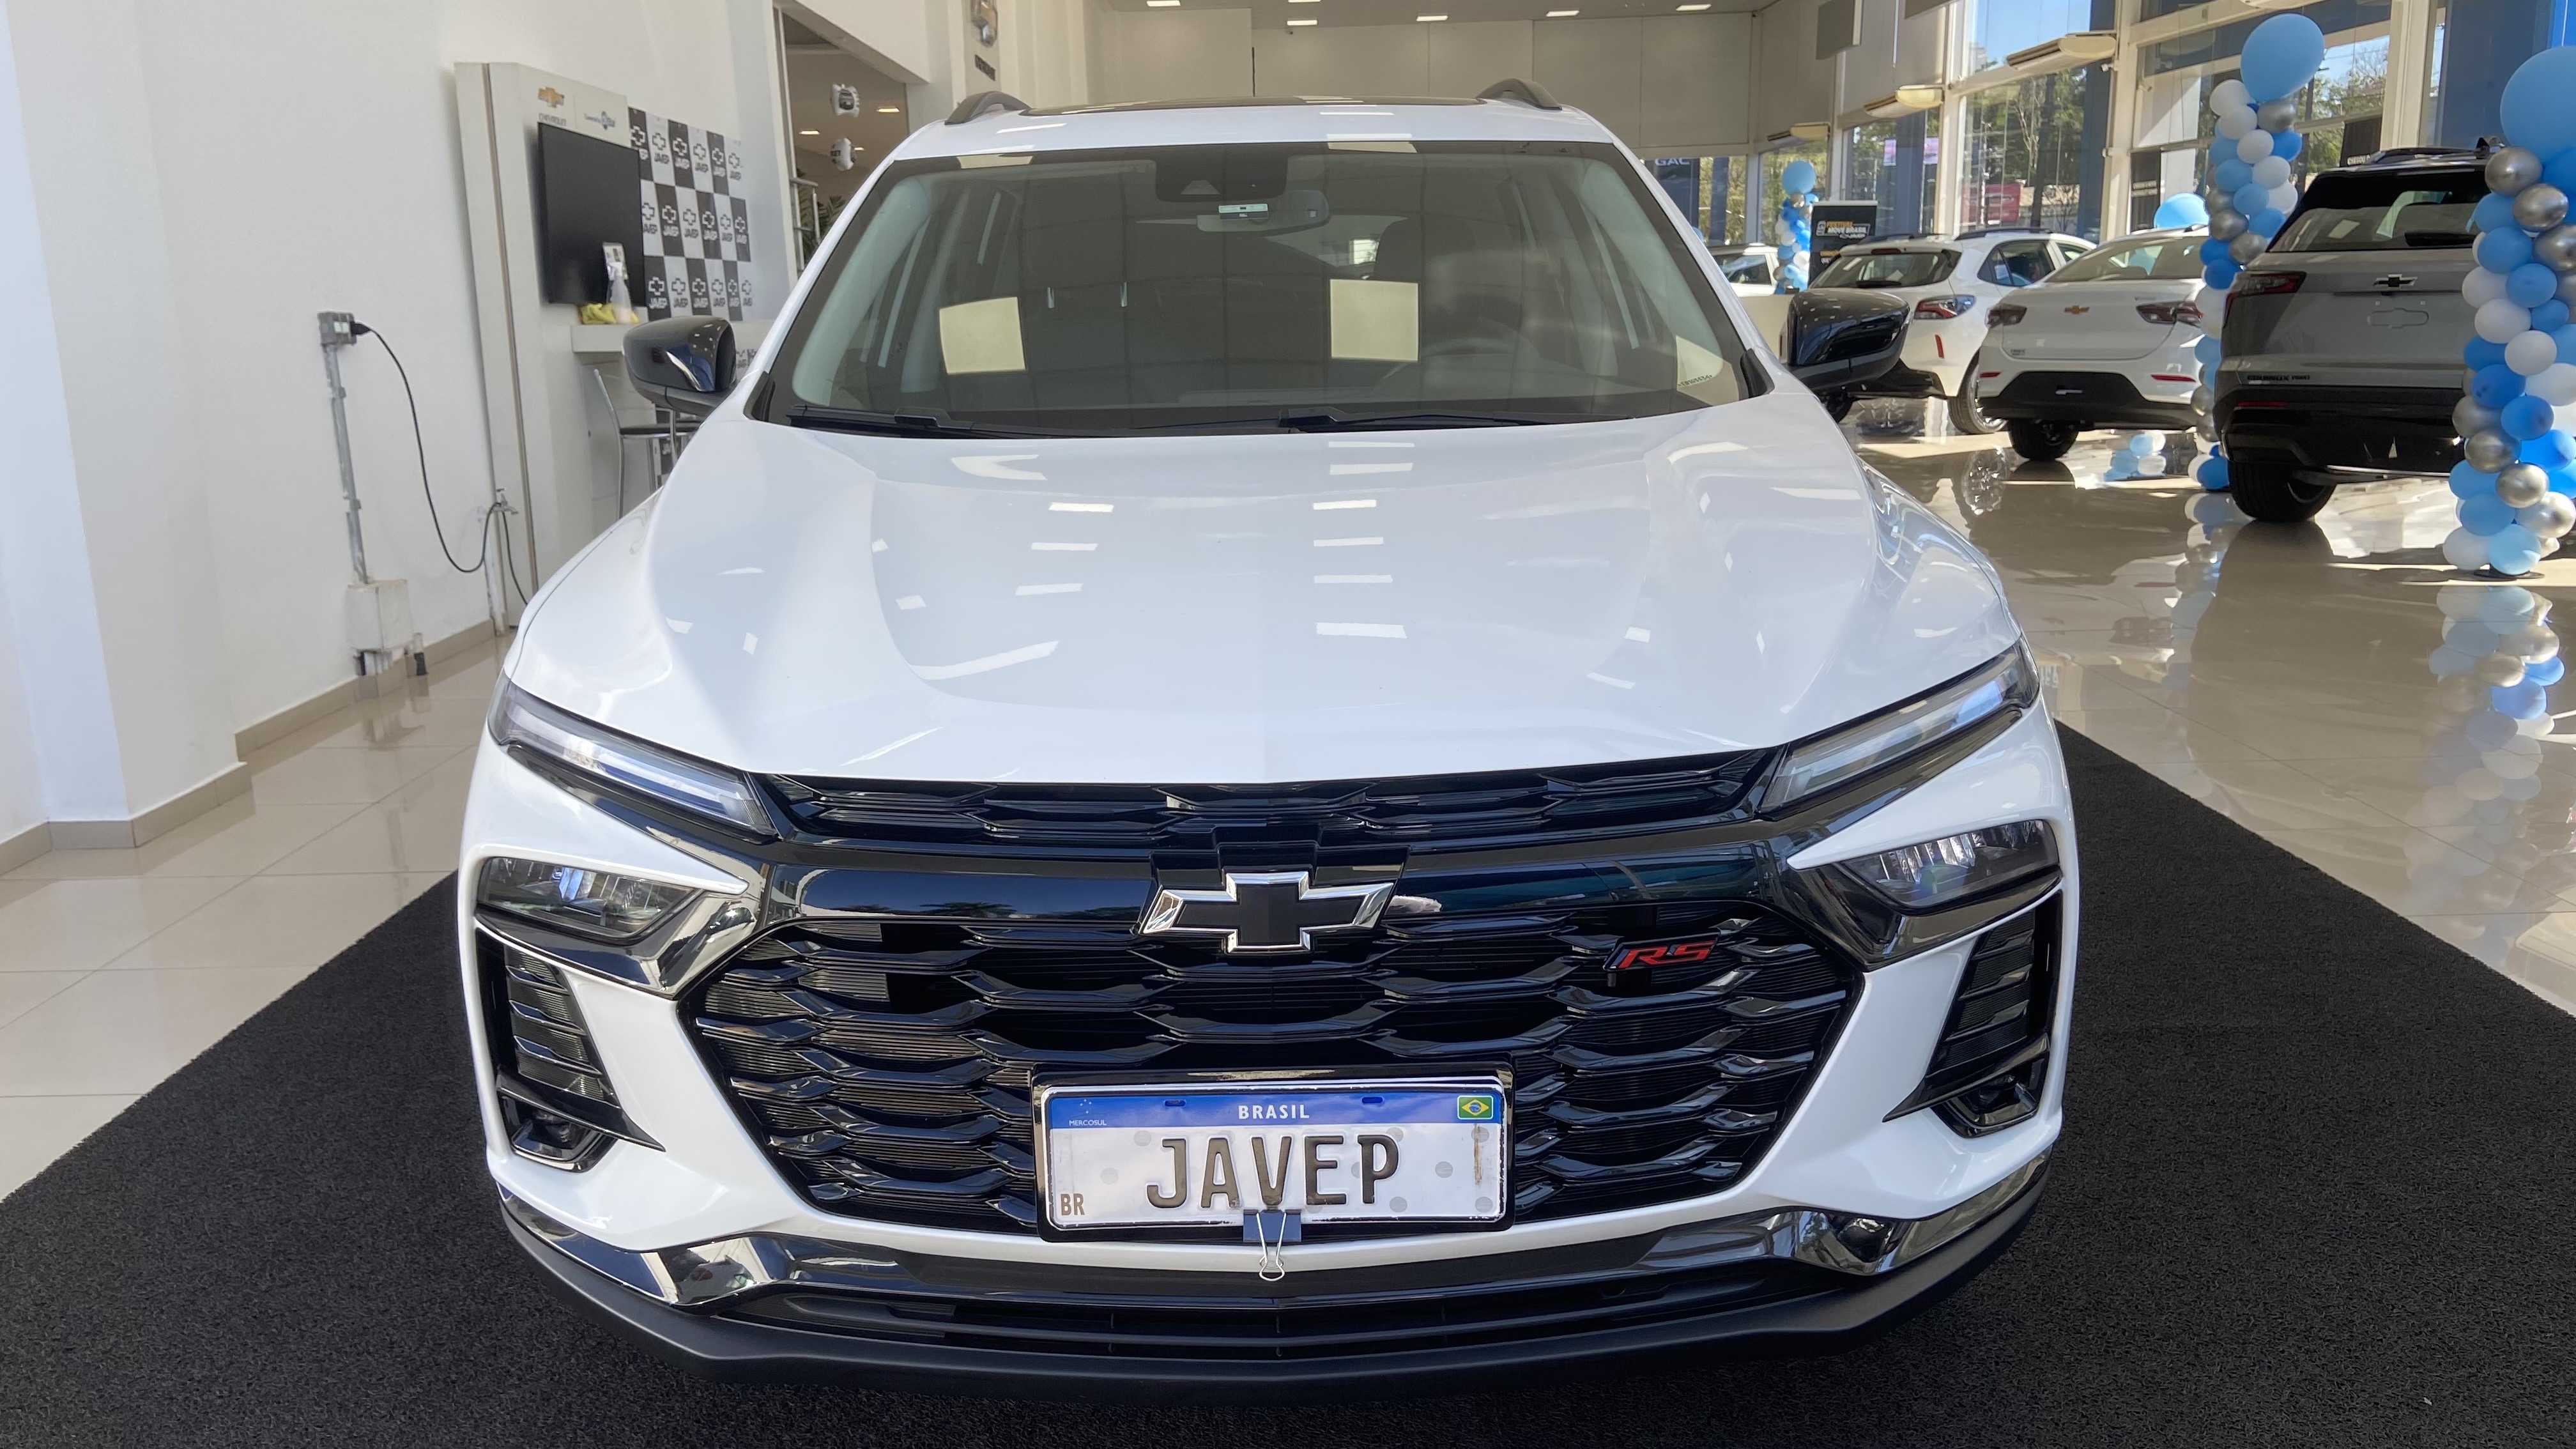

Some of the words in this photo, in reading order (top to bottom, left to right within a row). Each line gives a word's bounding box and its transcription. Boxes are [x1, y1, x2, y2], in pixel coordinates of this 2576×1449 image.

[1618, 942, 1716, 968] RS
[1238, 1104, 1310, 1120] BRASIL
[1147, 1135, 1400, 1208] JAVEP
[1061, 1193, 1085, 1216] BR
